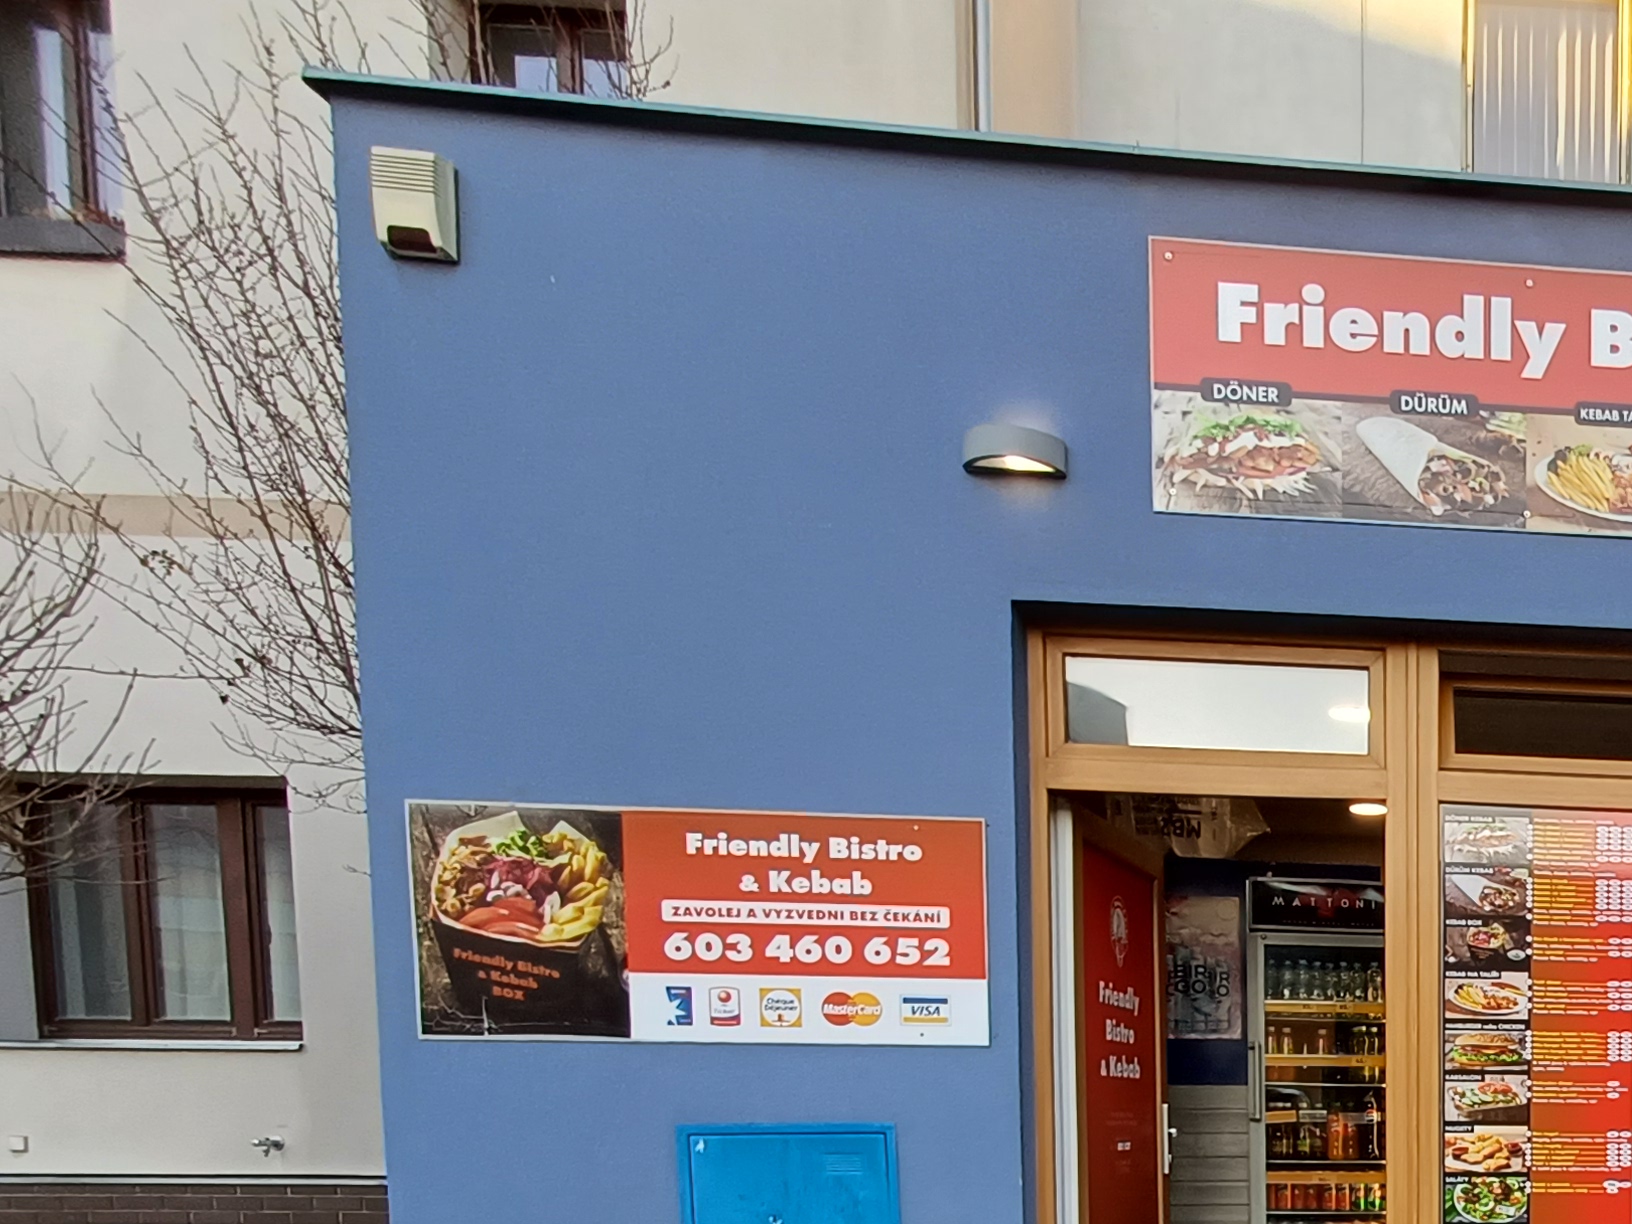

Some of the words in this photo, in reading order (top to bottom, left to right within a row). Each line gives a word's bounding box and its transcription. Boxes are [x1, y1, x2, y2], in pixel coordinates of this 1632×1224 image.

[1217, 281, 1566, 379] Friendly
[1213, 381, 1279, 403] DÖNER
[1401, 392, 1468, 415] DÜRÜM
[1580, 408, 1619, 422] KEBAB
[686, 832, 820, 863] Friendly
[829, 836, 923, 861] Bistro
[739, 874, 760, 893] &
[769, 870, 873, 895] Kebab
[1272, 896, 1375, 909] MATTONI
[671, 906, 741, 918] ZAVOLEJ
[747, 908, 758, 918] A
[762, 908, 844, 921] VYZVEDNI
[851, 910, 878, 922] BEZ
[883, 908, 941, 923] ČEKÁNÍ
[664, 932, 753, 962] 603
[765, 934, 852, 964] 460
[864, 936, 950, 966] 652
[453, 947, 513, 971] Friendly
[517, 961, 560, 978] Bistro
[490, 970, 538, 989] Kebab
[492, 985, 525, 1001] BOX
[1099, 980, 1140, 1016] Friendly
[823, 1004, 881, 1016] MasterCard
[911, 1006, 940, 1016] VISA
[1106, 1019, 1134, 1044] Bistro
[1109, 1055, 1140, 1079] Kebab
